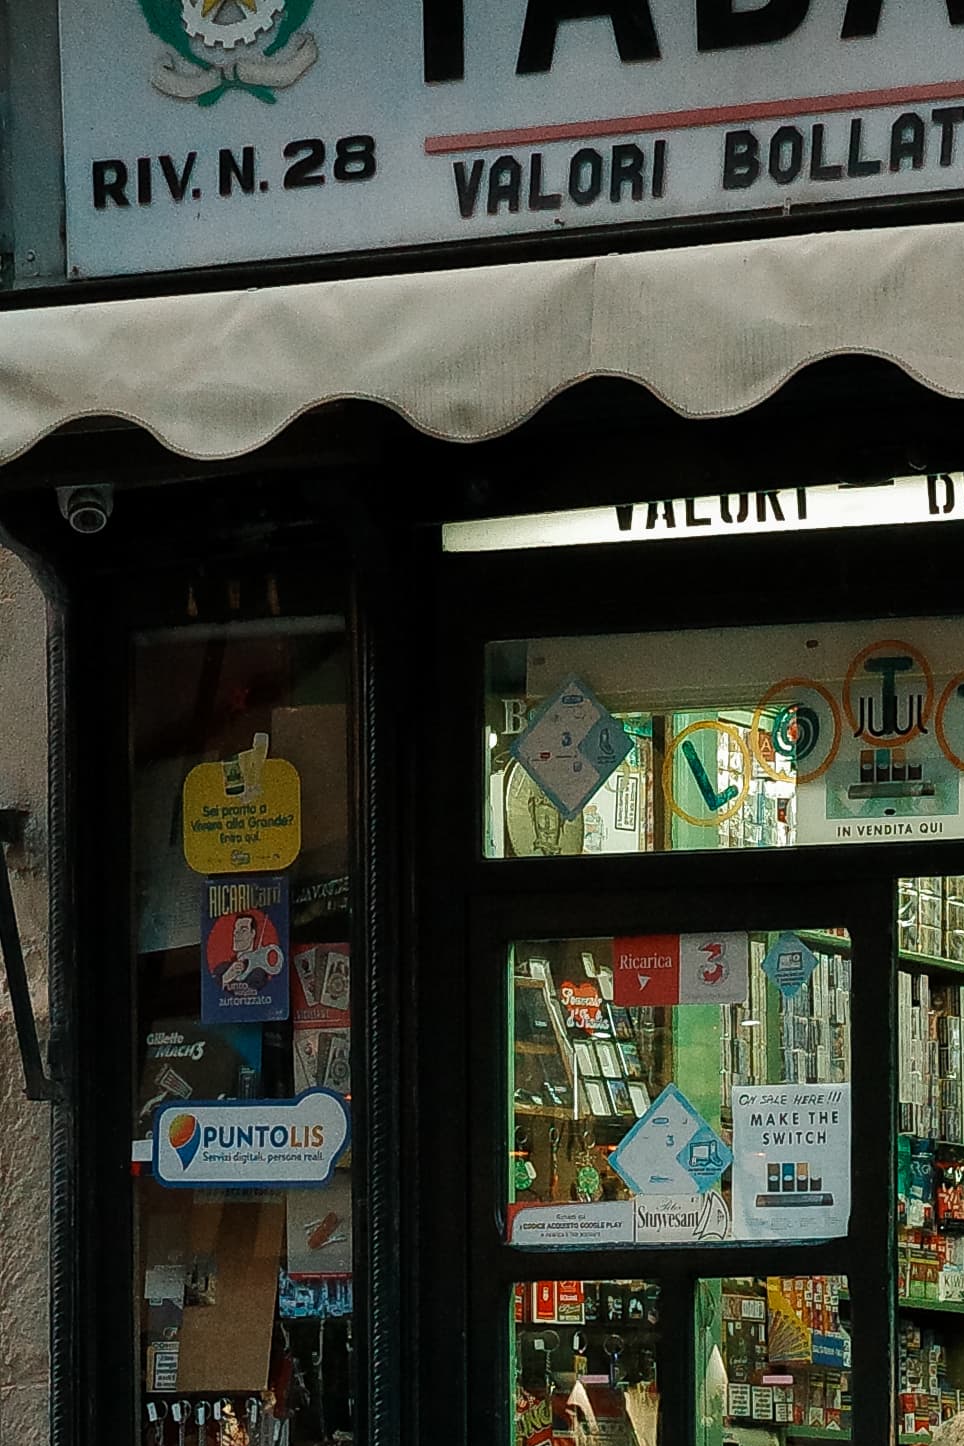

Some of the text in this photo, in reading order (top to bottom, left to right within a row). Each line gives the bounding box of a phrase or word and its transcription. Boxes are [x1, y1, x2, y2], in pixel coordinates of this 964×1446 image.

[92, 135, 377, 209] RIV. N. 28
[453, 139, 668, 218] VALORI
[225, 818, 245, 830] alla
[247, 814, 294, 828] Grande?
[837, 821, 943, 837] IN VENDITA QUI
[619, 953, 673, 970] Ricarica
[146, 1032, 184, 1045] Gillette
[155, 1041, 205, 1060] MACH3
[750, 1110, 839, 1126] MAKE THE
[203, 1125, 324, 1149] PUNTOLIS
[762, 1130, 827, 1146] SWITCH
[202, 1151, 231, 1162] Servizi
[267, 1152, 302, 1164] persone
[606, 1221, 623, 1229] PLAY
[637, 1206, 701, 1232] Stuyvesant
